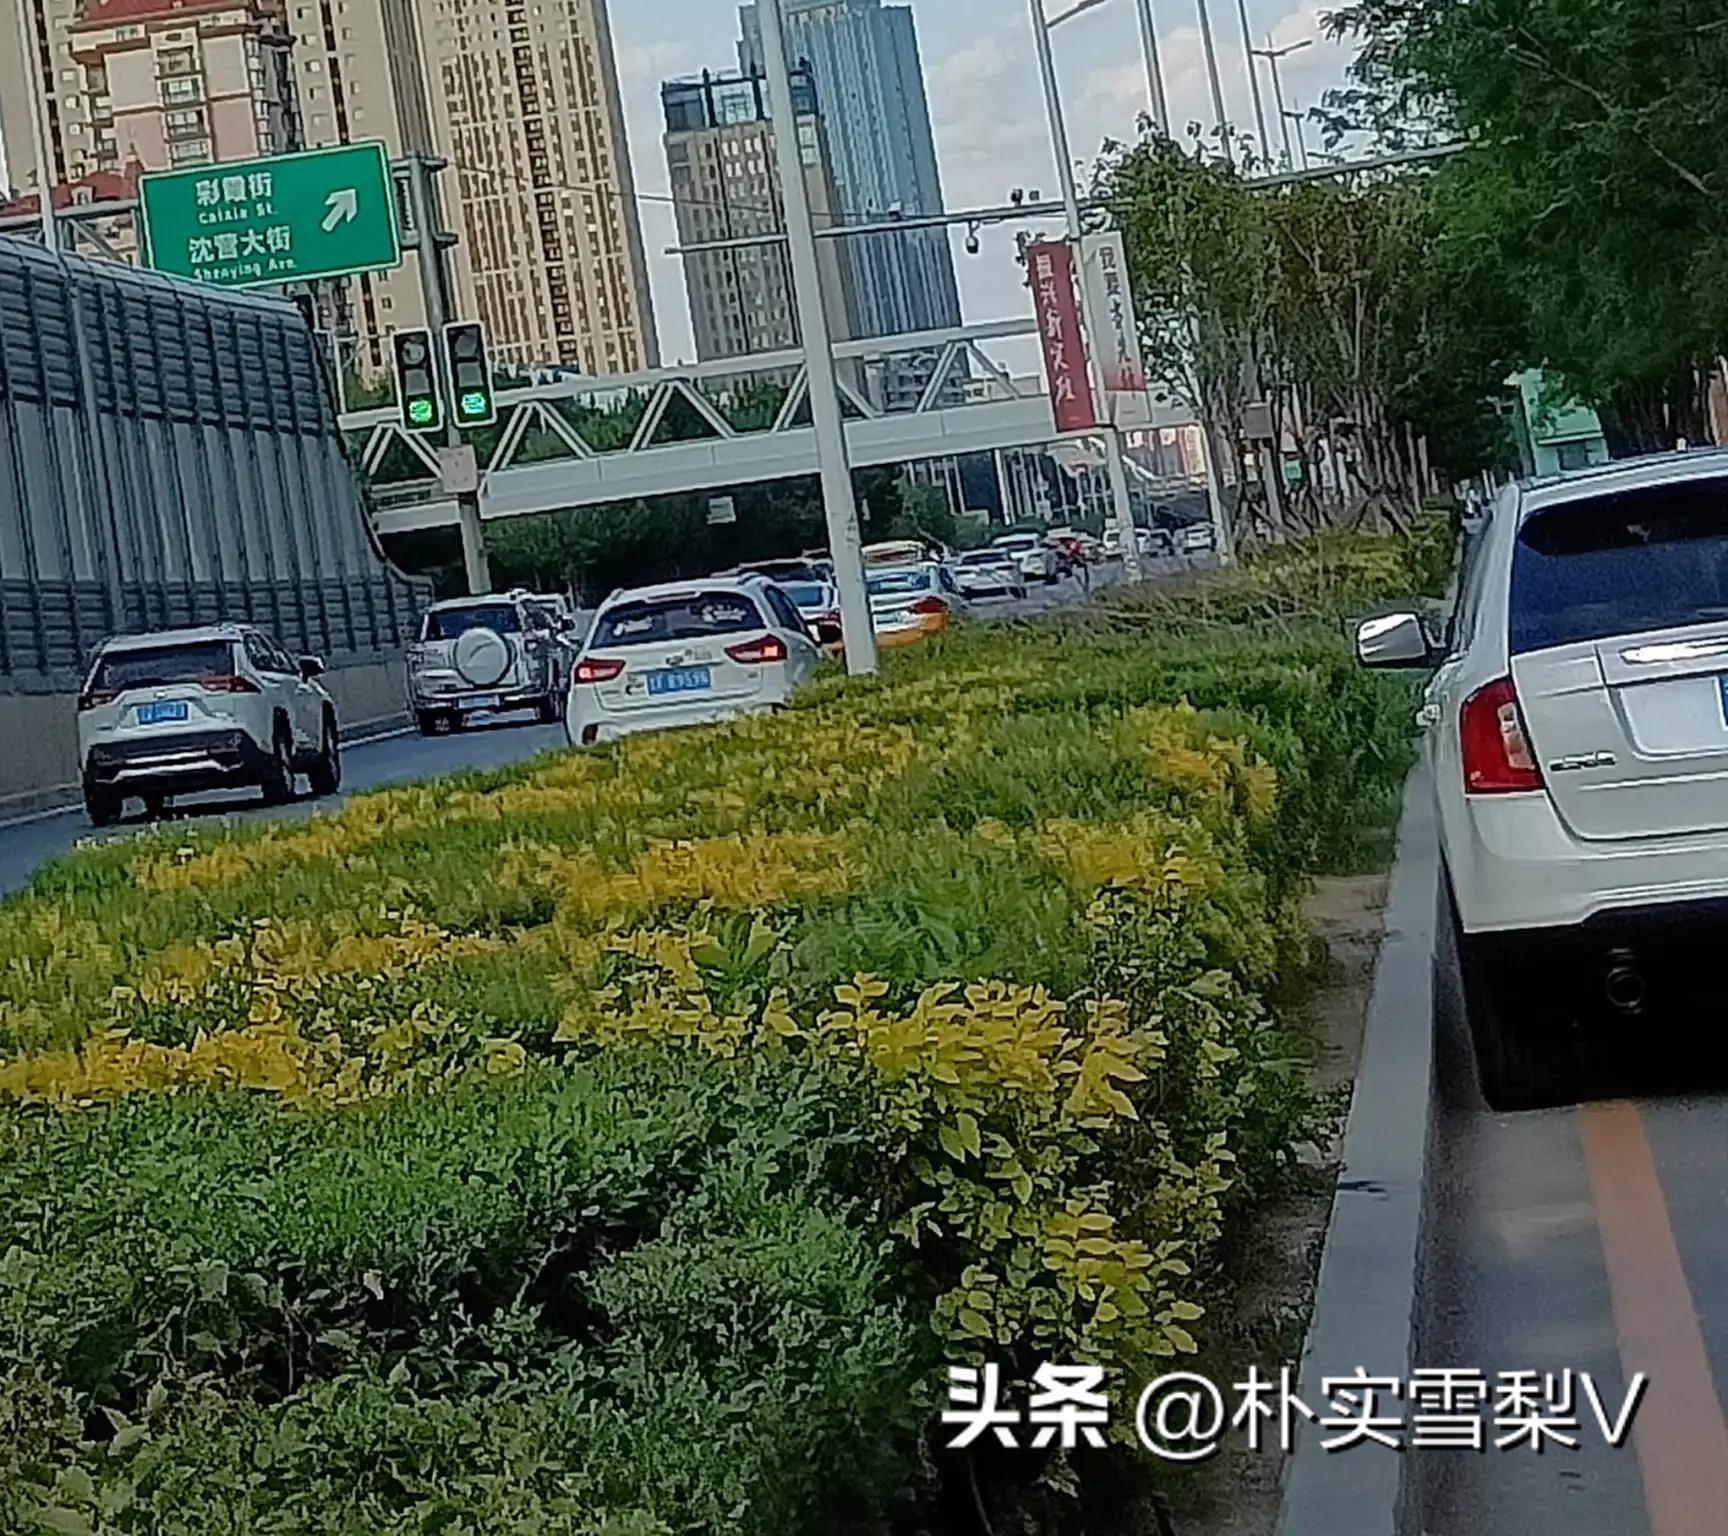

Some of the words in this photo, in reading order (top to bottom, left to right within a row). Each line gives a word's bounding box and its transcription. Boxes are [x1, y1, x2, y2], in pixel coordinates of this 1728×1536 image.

[195, 172, 273, 207] 彩霞街
[198, 206, 248, 225] Caixia
[188, 225, 290, 264] 沈营大街
